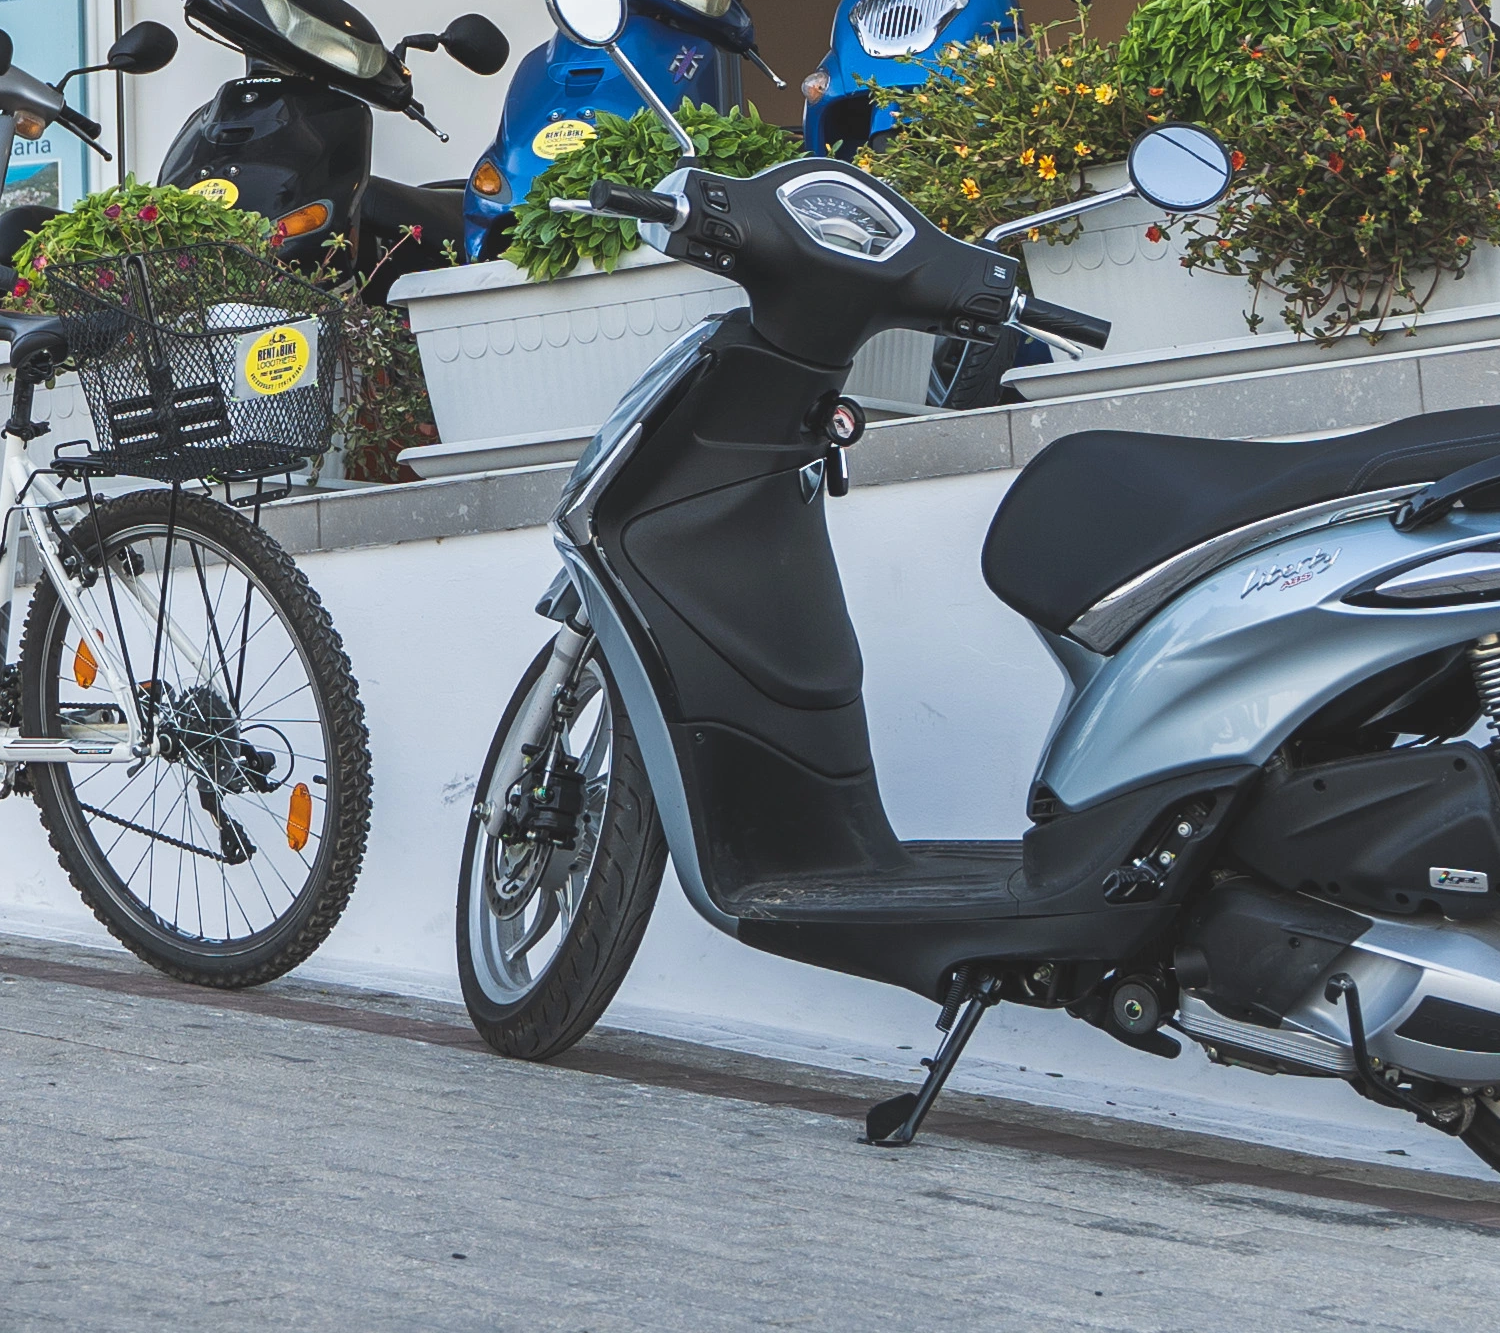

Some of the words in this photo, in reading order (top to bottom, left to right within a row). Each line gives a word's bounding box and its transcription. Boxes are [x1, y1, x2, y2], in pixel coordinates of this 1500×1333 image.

[258, 347, 275, 362] RENT
[280, 342, 296, 357] BIKE
[1241, 547, 1342, 599] Liberty
[1280, 573, 1313, 590] ABS
